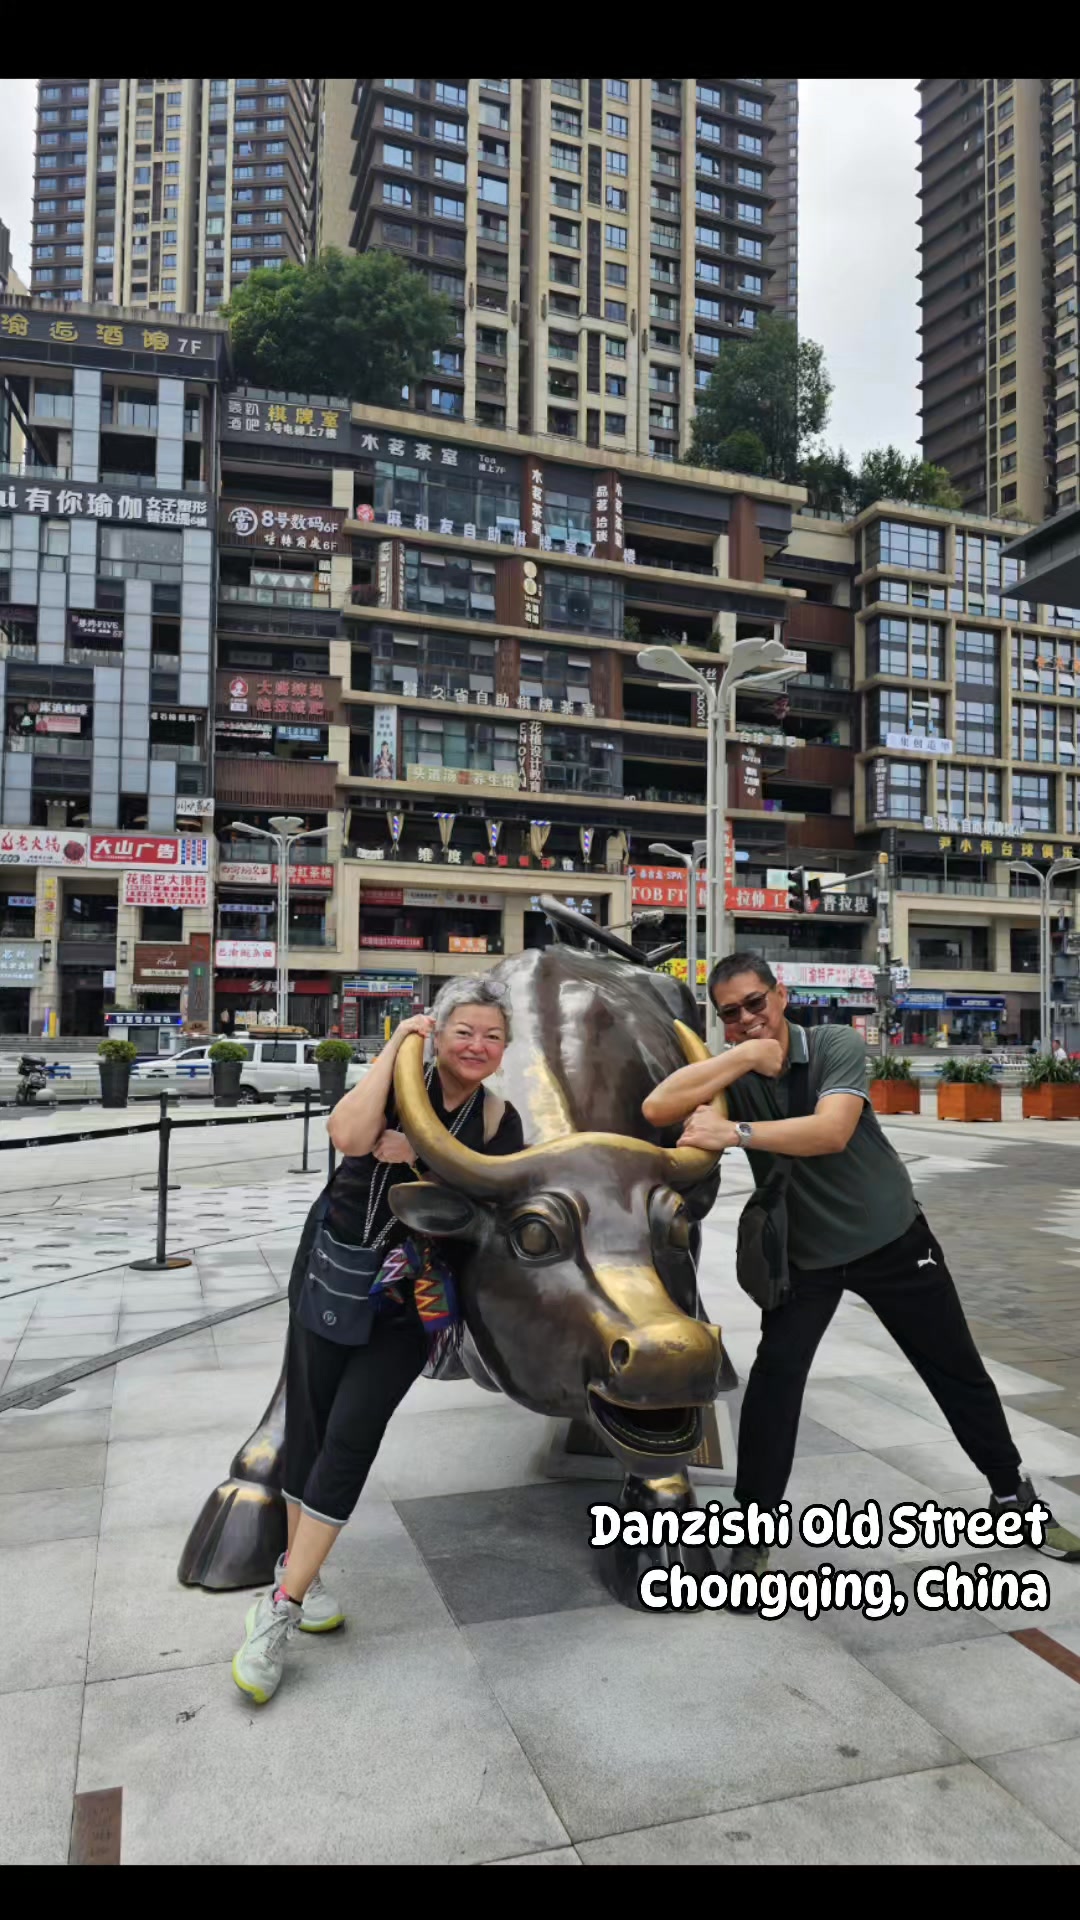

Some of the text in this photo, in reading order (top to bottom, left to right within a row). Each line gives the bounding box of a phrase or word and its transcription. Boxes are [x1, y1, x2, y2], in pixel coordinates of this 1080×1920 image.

[178, 338, 201, 354] 7F
[228, 416, 260, 432] 酒吧
[268, 405, 338, 429] 棋牌室
[361, 434, 458, 467] 水茗茶室
[25, 488, 142, 519] 有你瑜伽
[531, 469, 542, 536] 水茗茶室
[94, 839, 176, 859] 大山广告
[823, 894, 869, 912] 普拉提
